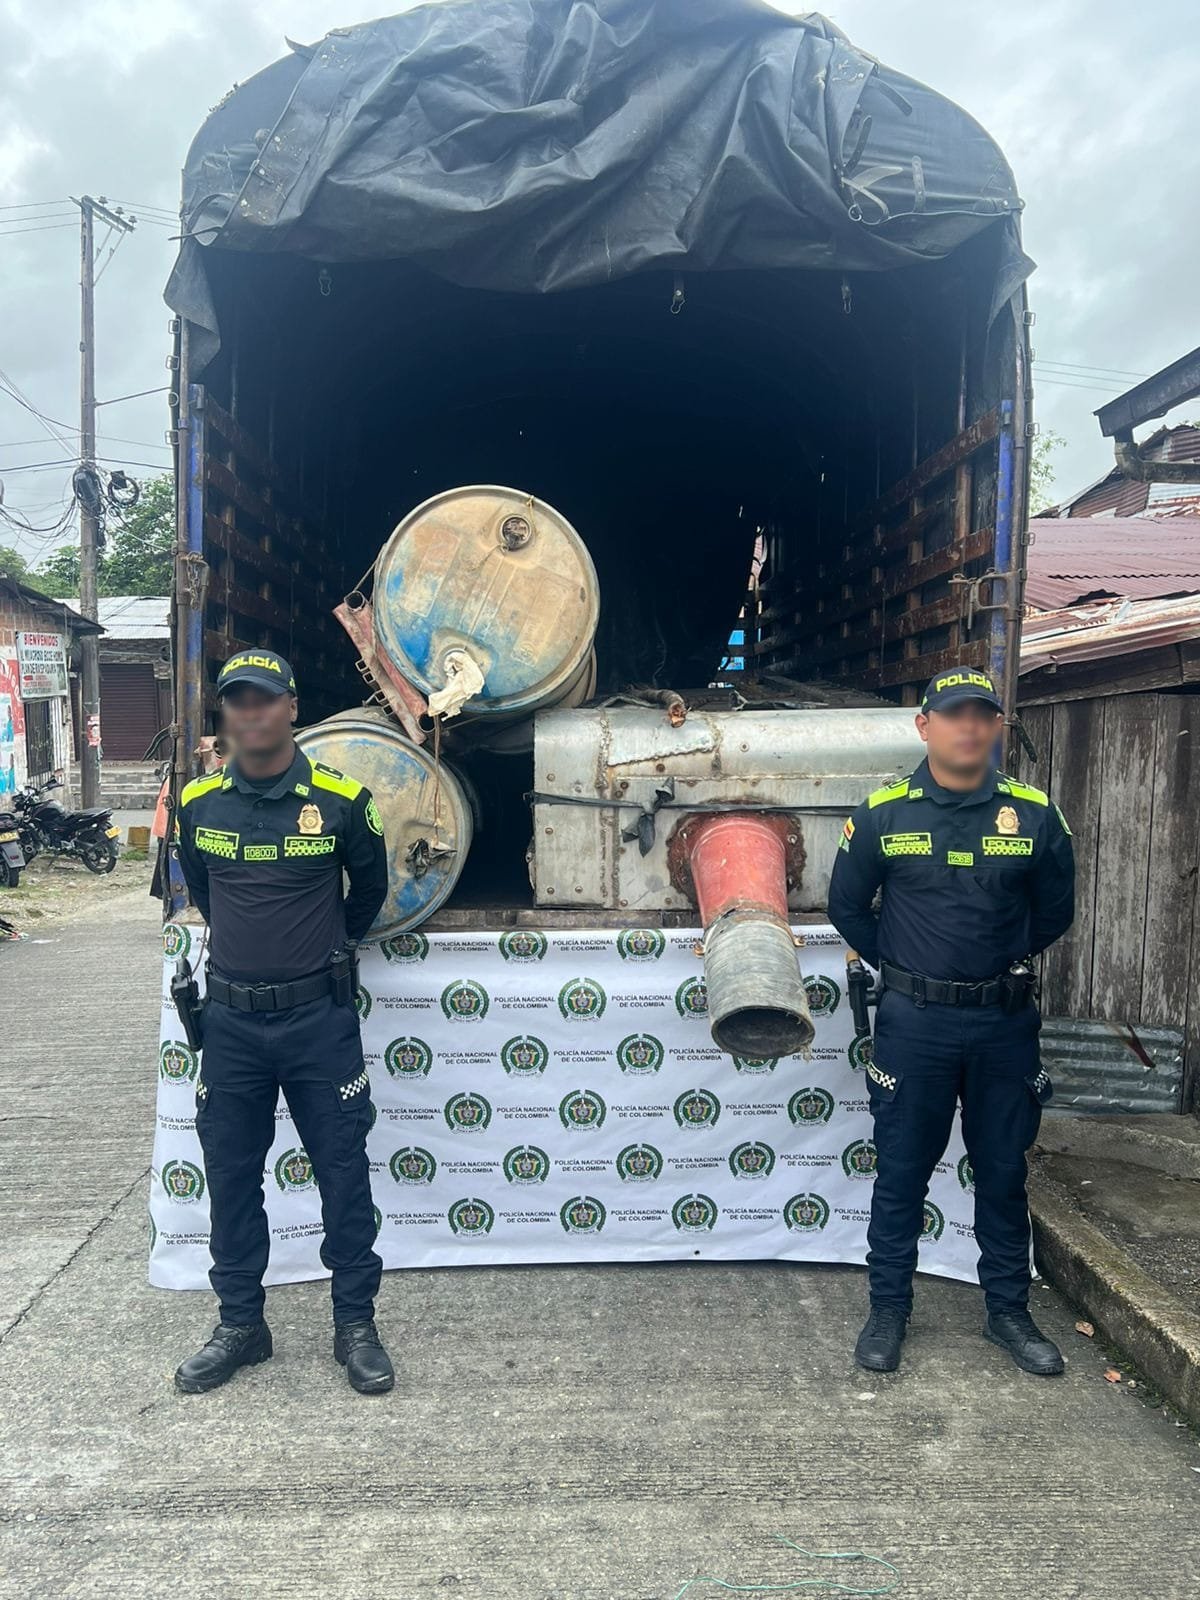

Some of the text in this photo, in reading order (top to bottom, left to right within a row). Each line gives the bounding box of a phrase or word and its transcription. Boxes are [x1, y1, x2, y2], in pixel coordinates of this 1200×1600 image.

[222, 655, 282, 677] POLICÍA
[936, 672, 993, 692] POLICÍA
[289, 839, 330, 848] POLICÍA
[988, 840, 1027, 849] POLICÍA
[272, 1225, 298, 1234] POLICÍA
